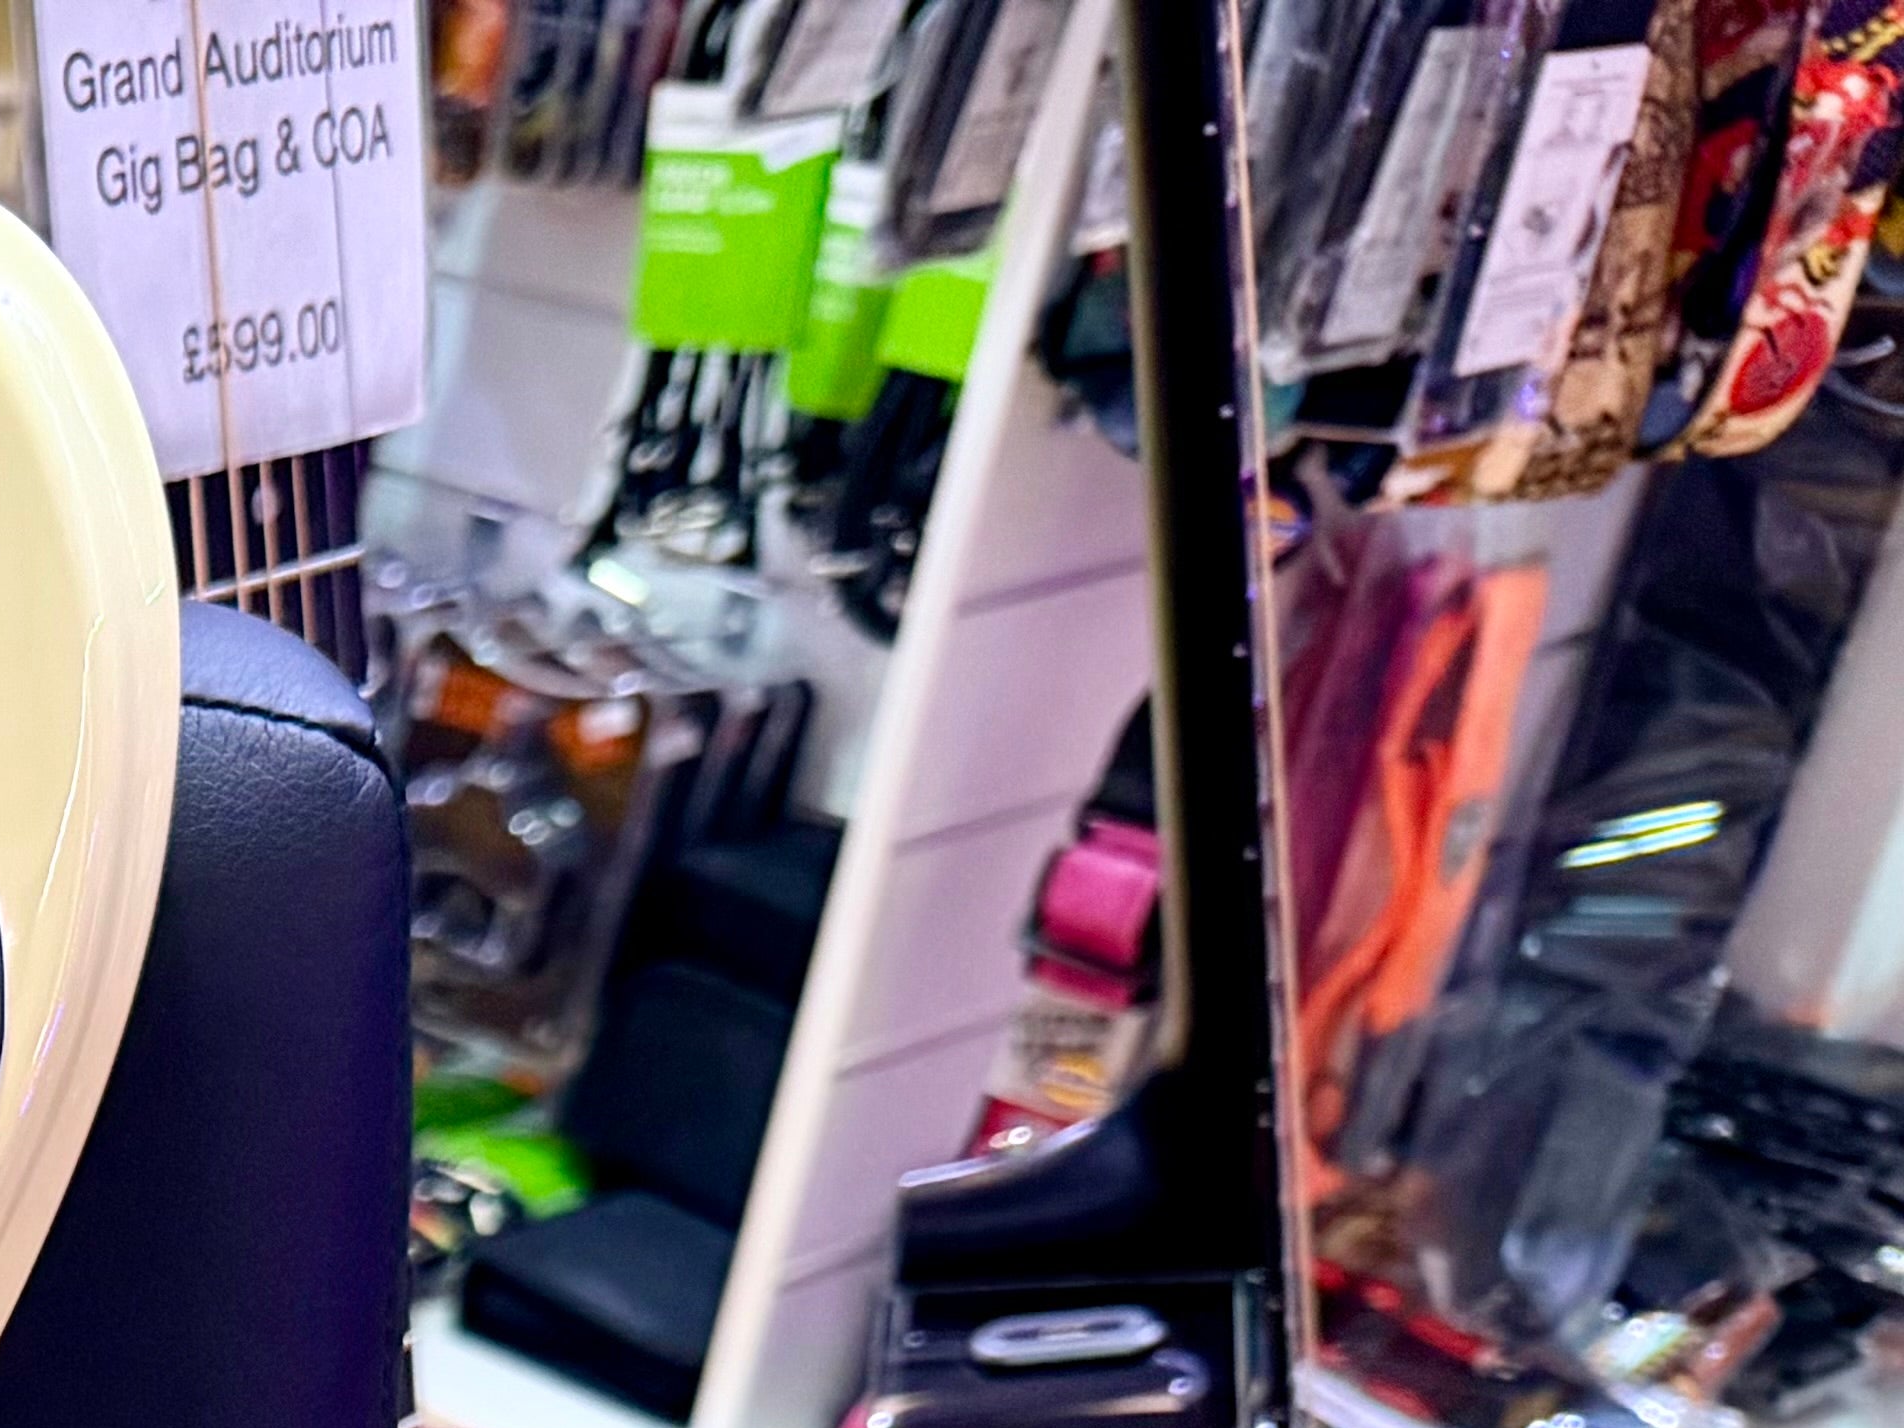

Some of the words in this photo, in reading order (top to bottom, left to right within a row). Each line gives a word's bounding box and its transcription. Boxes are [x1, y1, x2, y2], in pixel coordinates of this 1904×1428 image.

[63, 38, 184, 112] Grand
[203, 14, 397, 89] Auditorium
[96, 144, 163, 216] Gig
[175, 134, 260, 198] Bag
[274, 117, 302, 176] &
[312, 103, 393, 170] COA
[182, 299, 340, 383] £599.00
